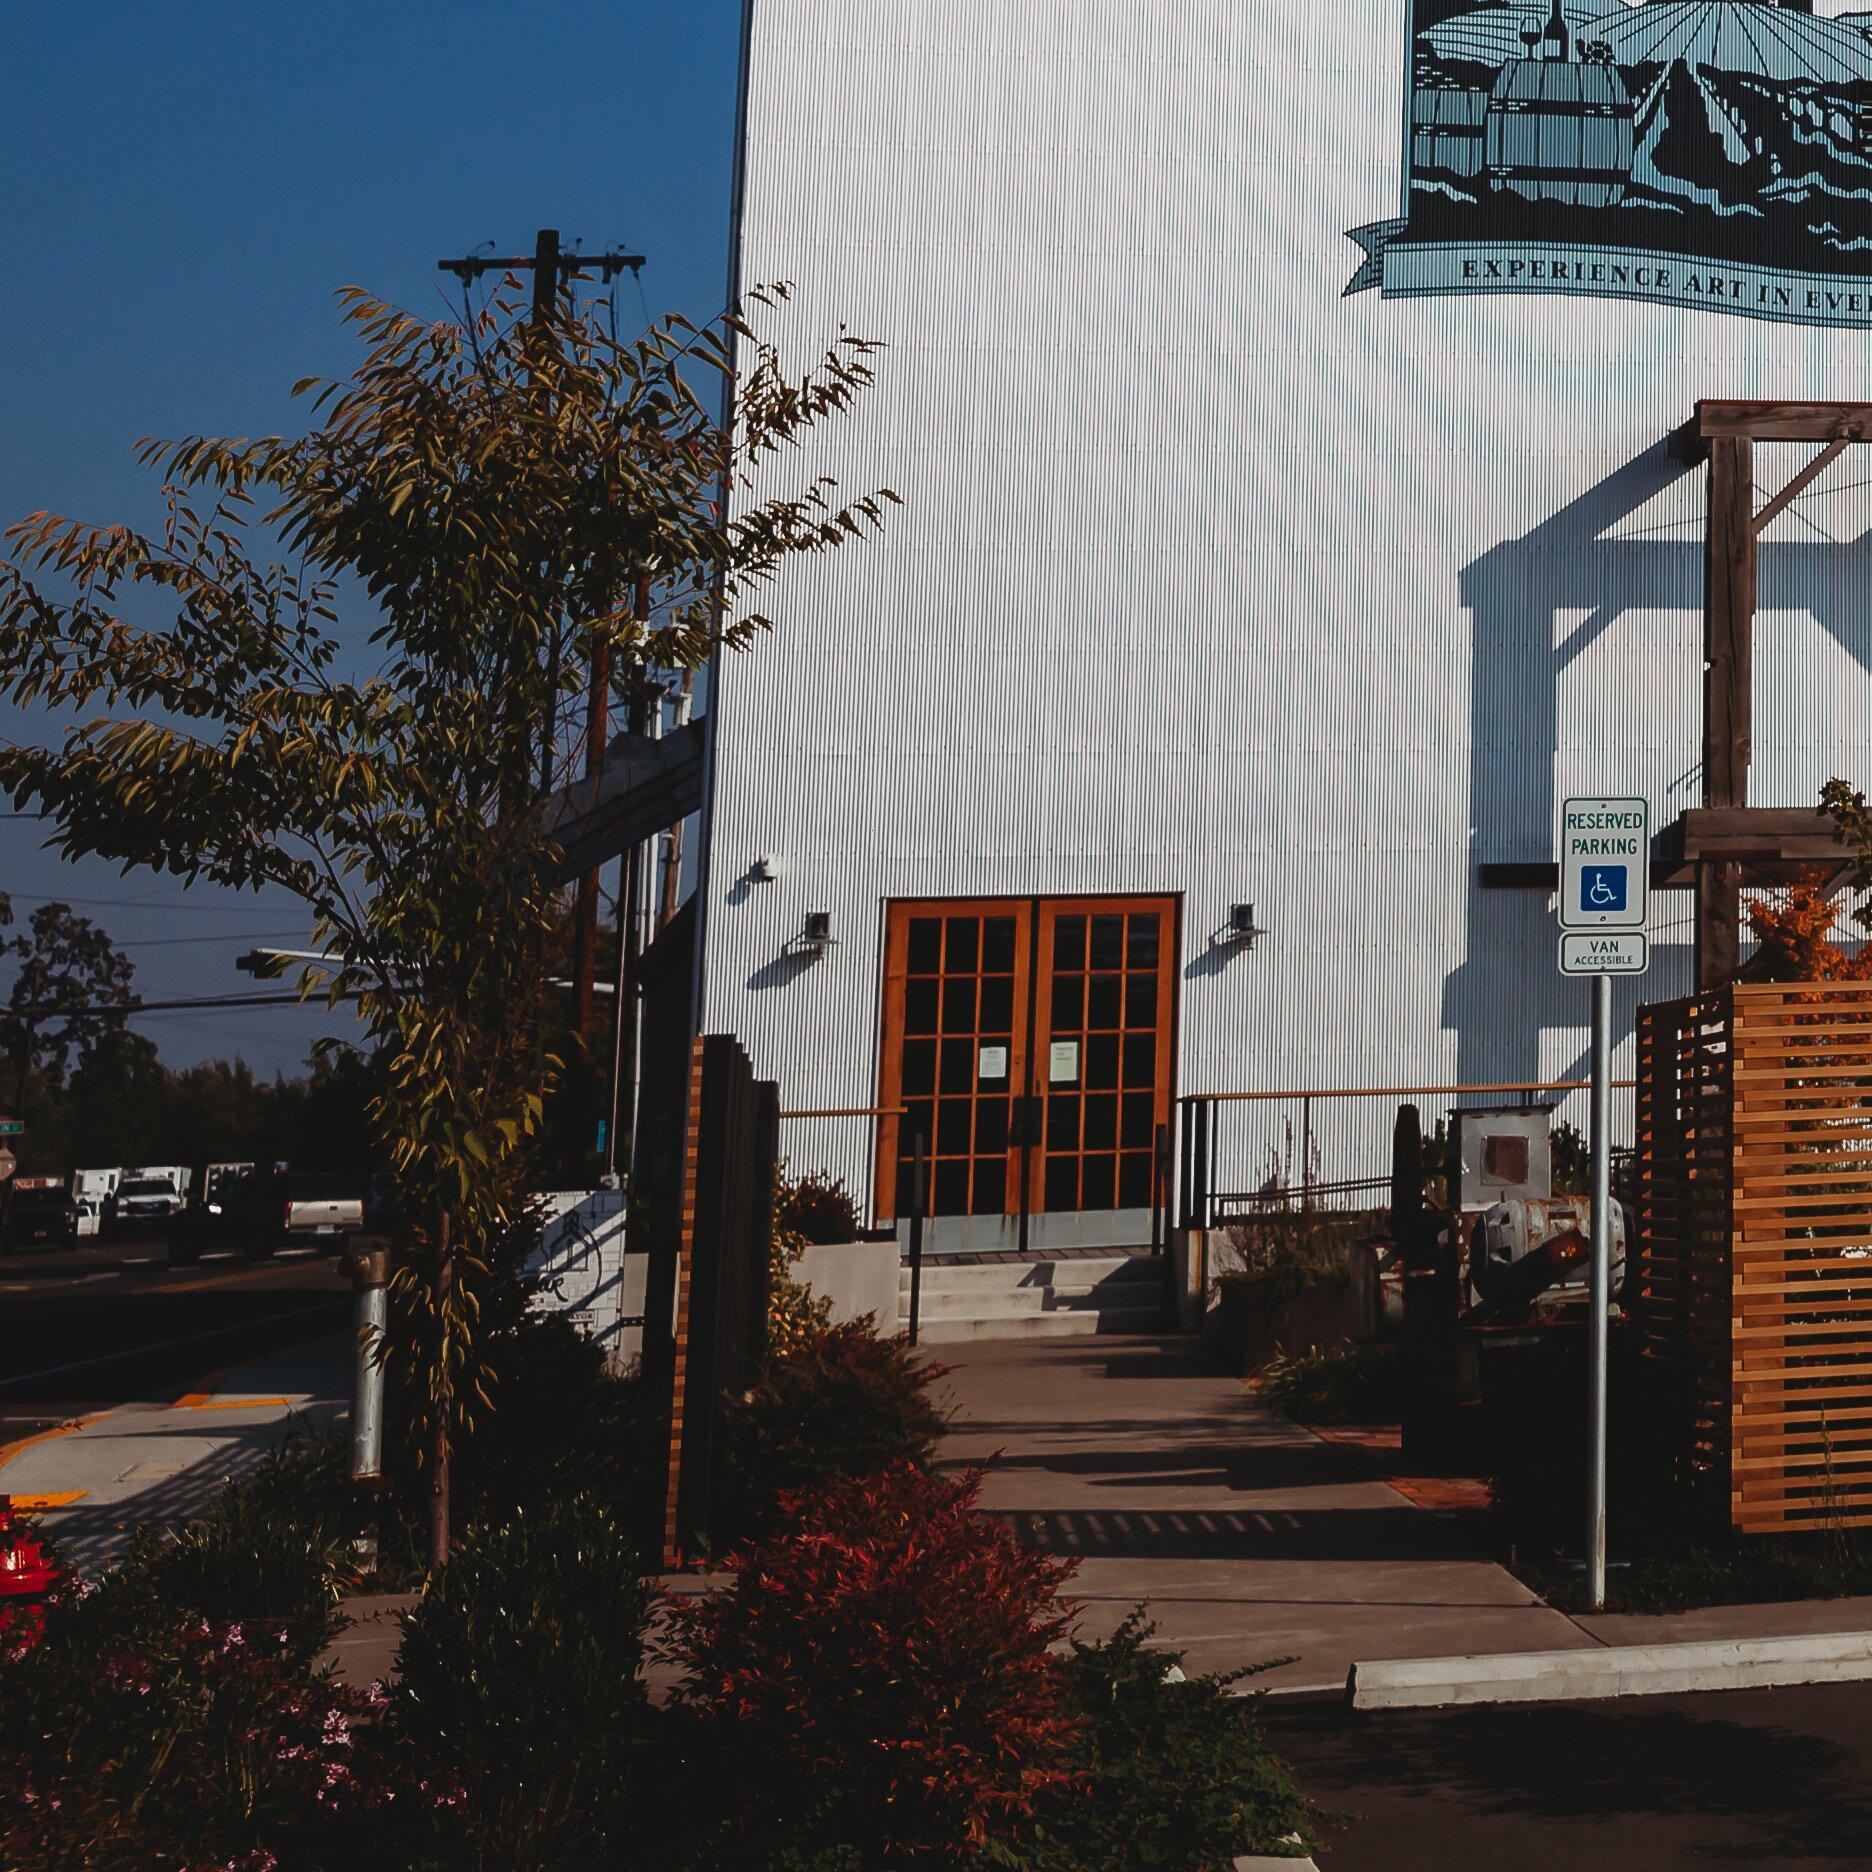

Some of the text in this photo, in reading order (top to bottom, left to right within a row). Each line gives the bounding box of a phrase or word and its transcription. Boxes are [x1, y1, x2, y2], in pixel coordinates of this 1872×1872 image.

[1461, 258, 1672, 288] EXPERIENCE
[1683, 273, 1746, 299] ART
[1758, 283, 1792, 306] IN
[1567, 812, 1643, 829] RESERVED
[1571, 838, 1638, 855] PARKING
[1589, 940, 1619, 954] VAN
[1574, 954, 1634, 965] ACCESSIBLE
